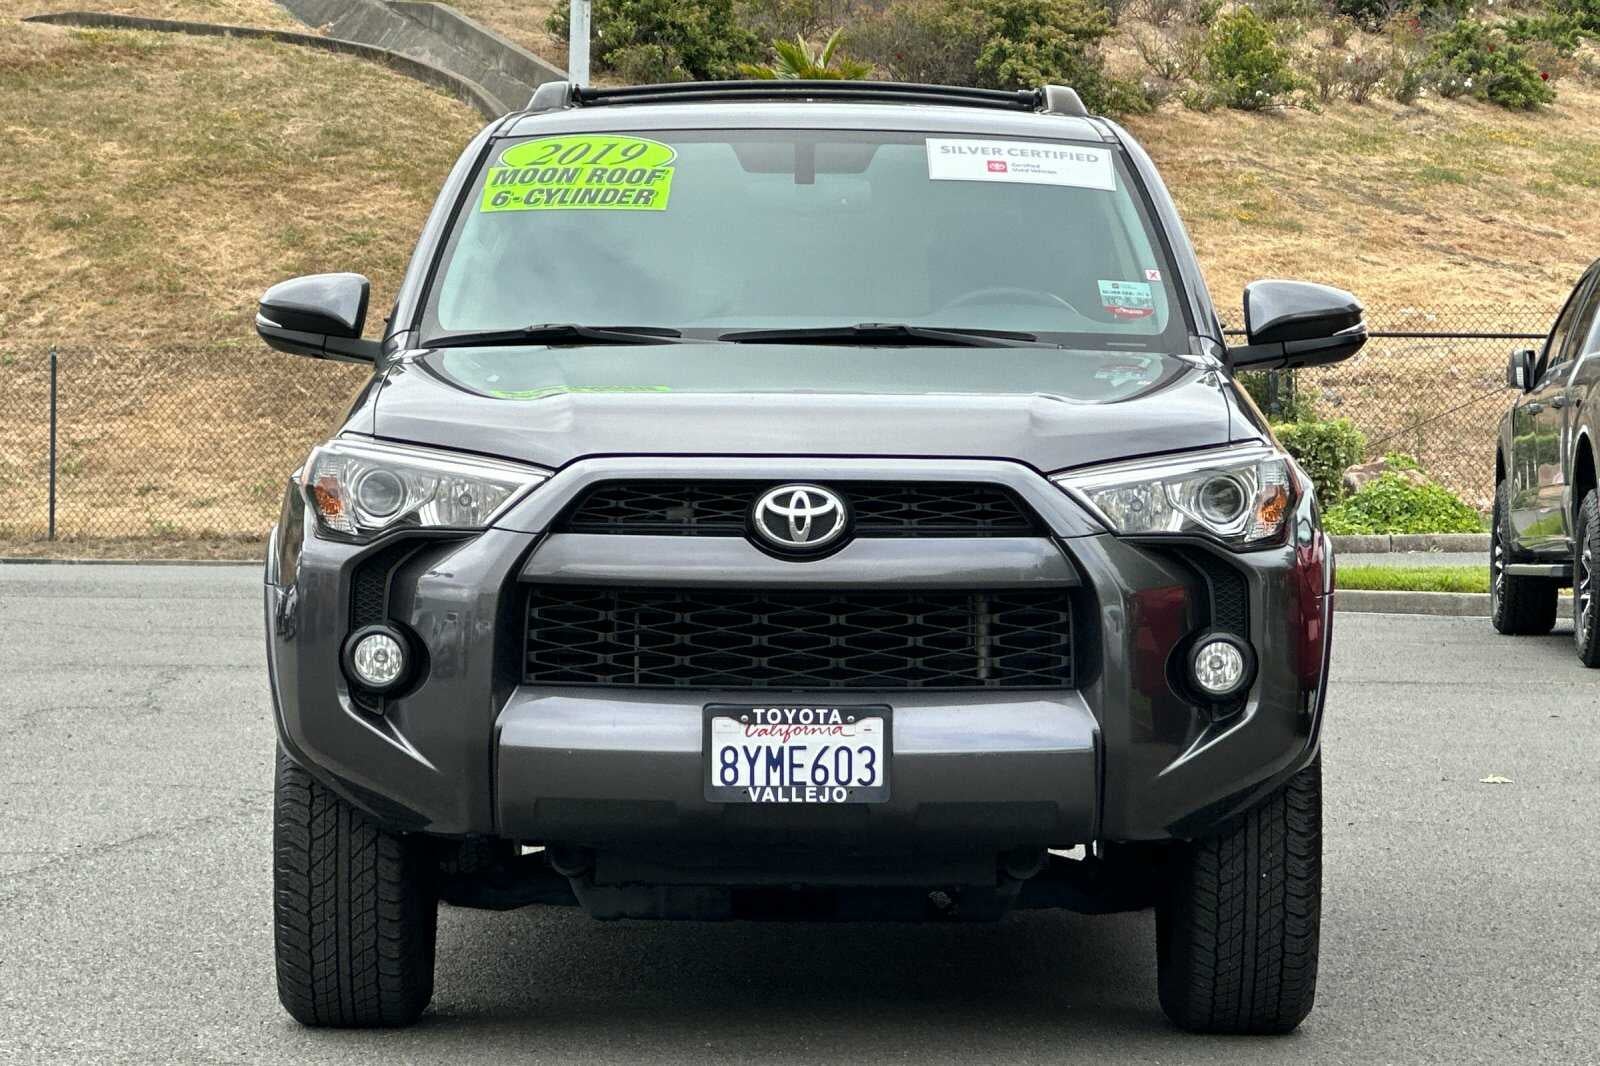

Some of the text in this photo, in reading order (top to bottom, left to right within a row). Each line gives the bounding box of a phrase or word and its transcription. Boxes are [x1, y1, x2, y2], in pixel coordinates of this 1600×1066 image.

[526, 143, 648, 167] 2019
[941, 145, 1099, 163] SILVER CERTIFIED
[492, 168, 669, 187] MOON ROOF
[492, 188, 658, 207] 6-CYLINDER
[752, 708, 843, 724] TOYOTA
[745, 724, 855, 743] California
[720, 745, 876, 786] 8YME603
[747, 787, 847, 803] VALLEJO
